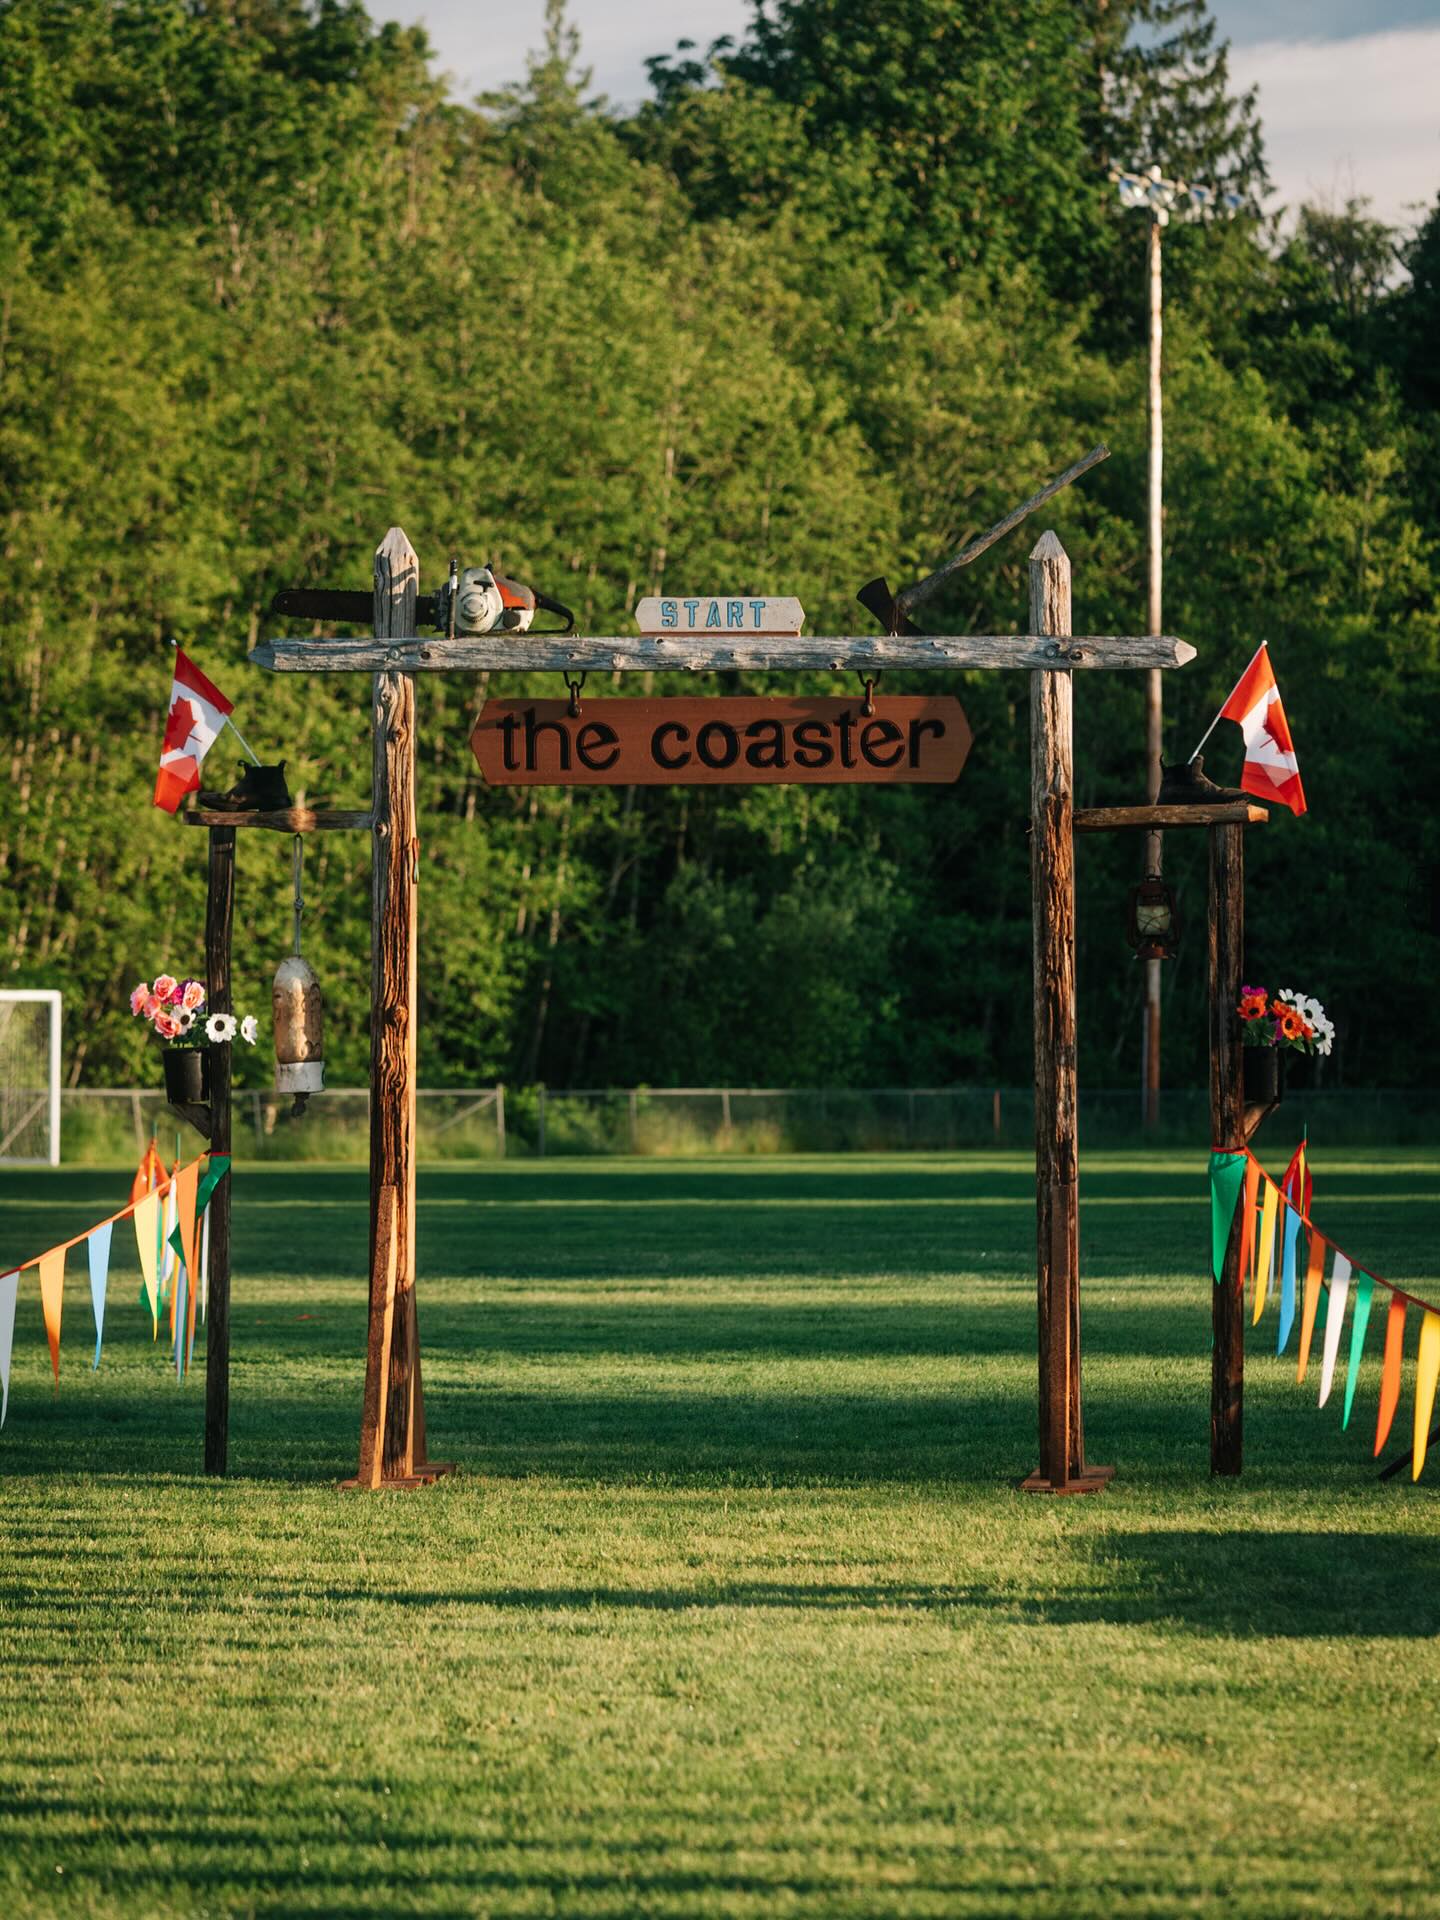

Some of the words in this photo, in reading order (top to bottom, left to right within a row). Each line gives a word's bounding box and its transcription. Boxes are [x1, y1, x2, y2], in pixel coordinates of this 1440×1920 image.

[661, 601, 765, 627] START
[496, 709, 620, 771] the
[651, 711, 946, 769] coaster
